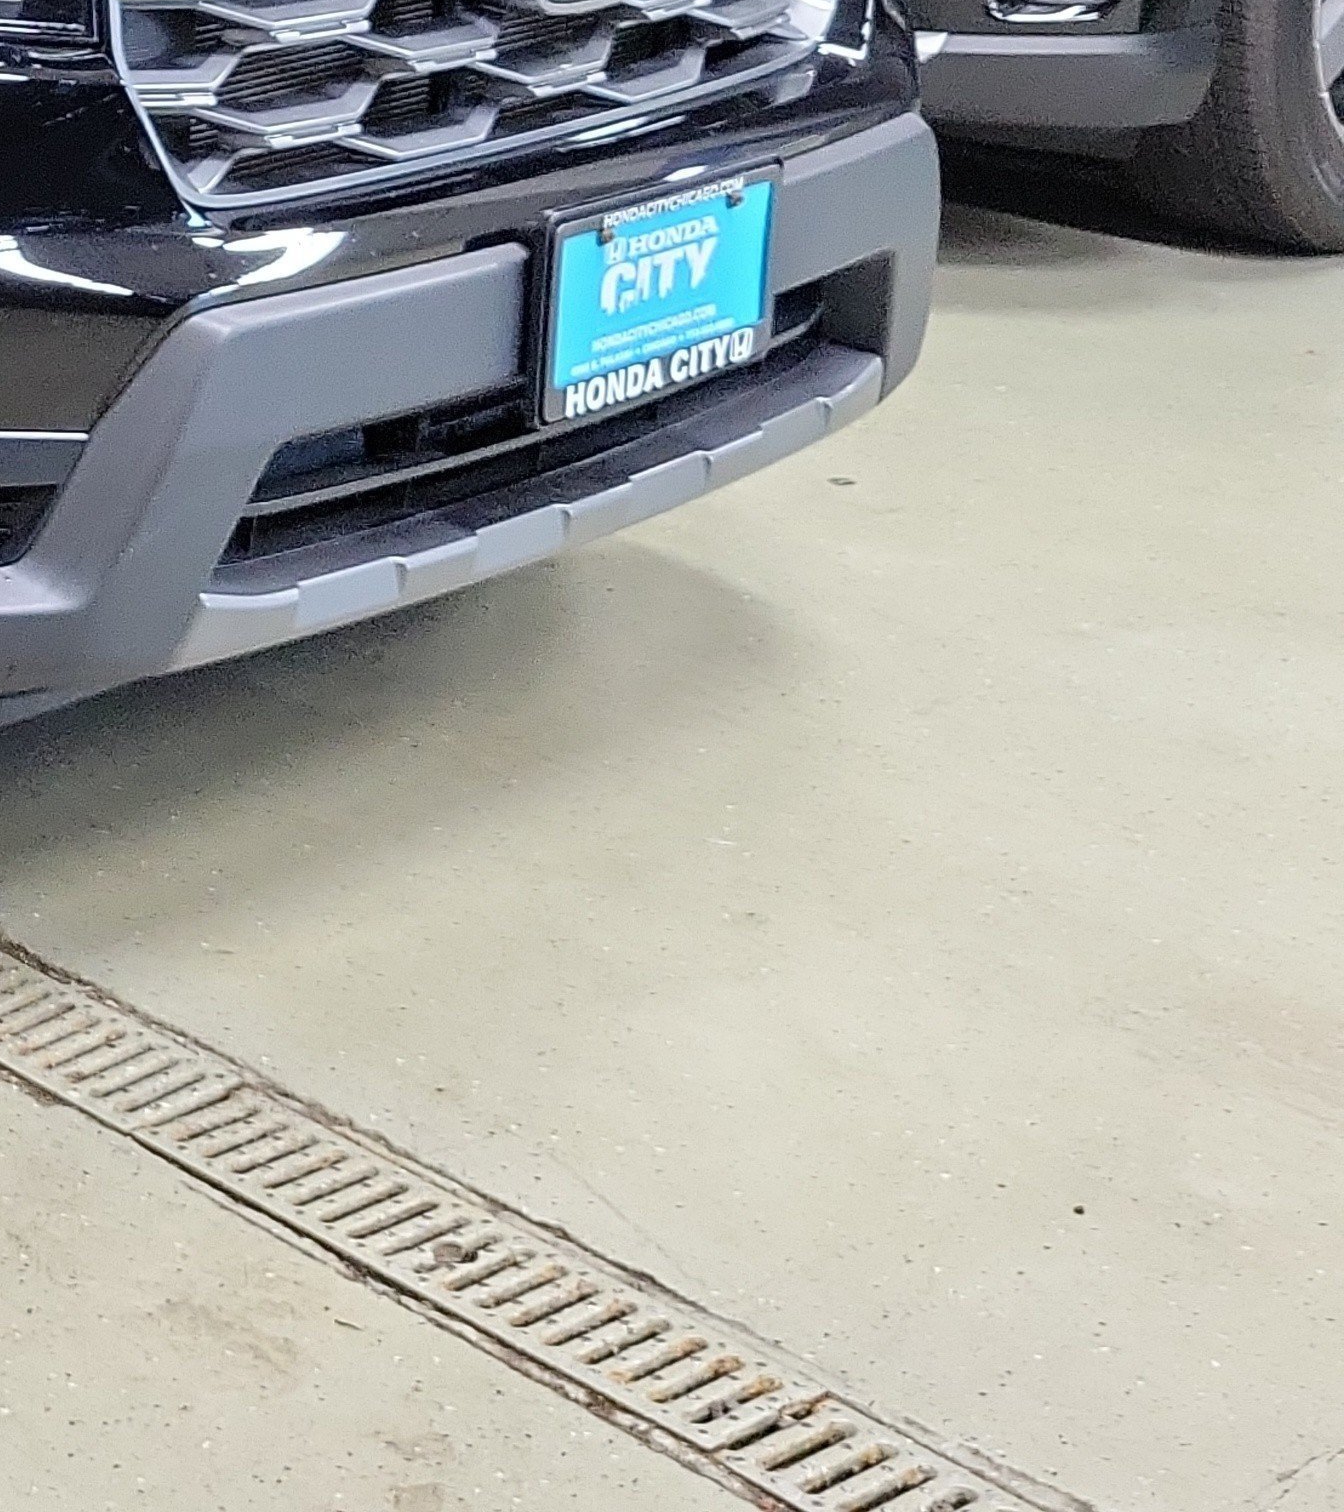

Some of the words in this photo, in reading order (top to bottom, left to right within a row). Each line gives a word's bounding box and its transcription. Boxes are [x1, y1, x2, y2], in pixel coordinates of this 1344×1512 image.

[628, 215, 719, 255] HONDA
[600, 237, 719, 315] CITY
[565, 358, 664, 418] HONDA
[670, 335, 732, 383] CITY
